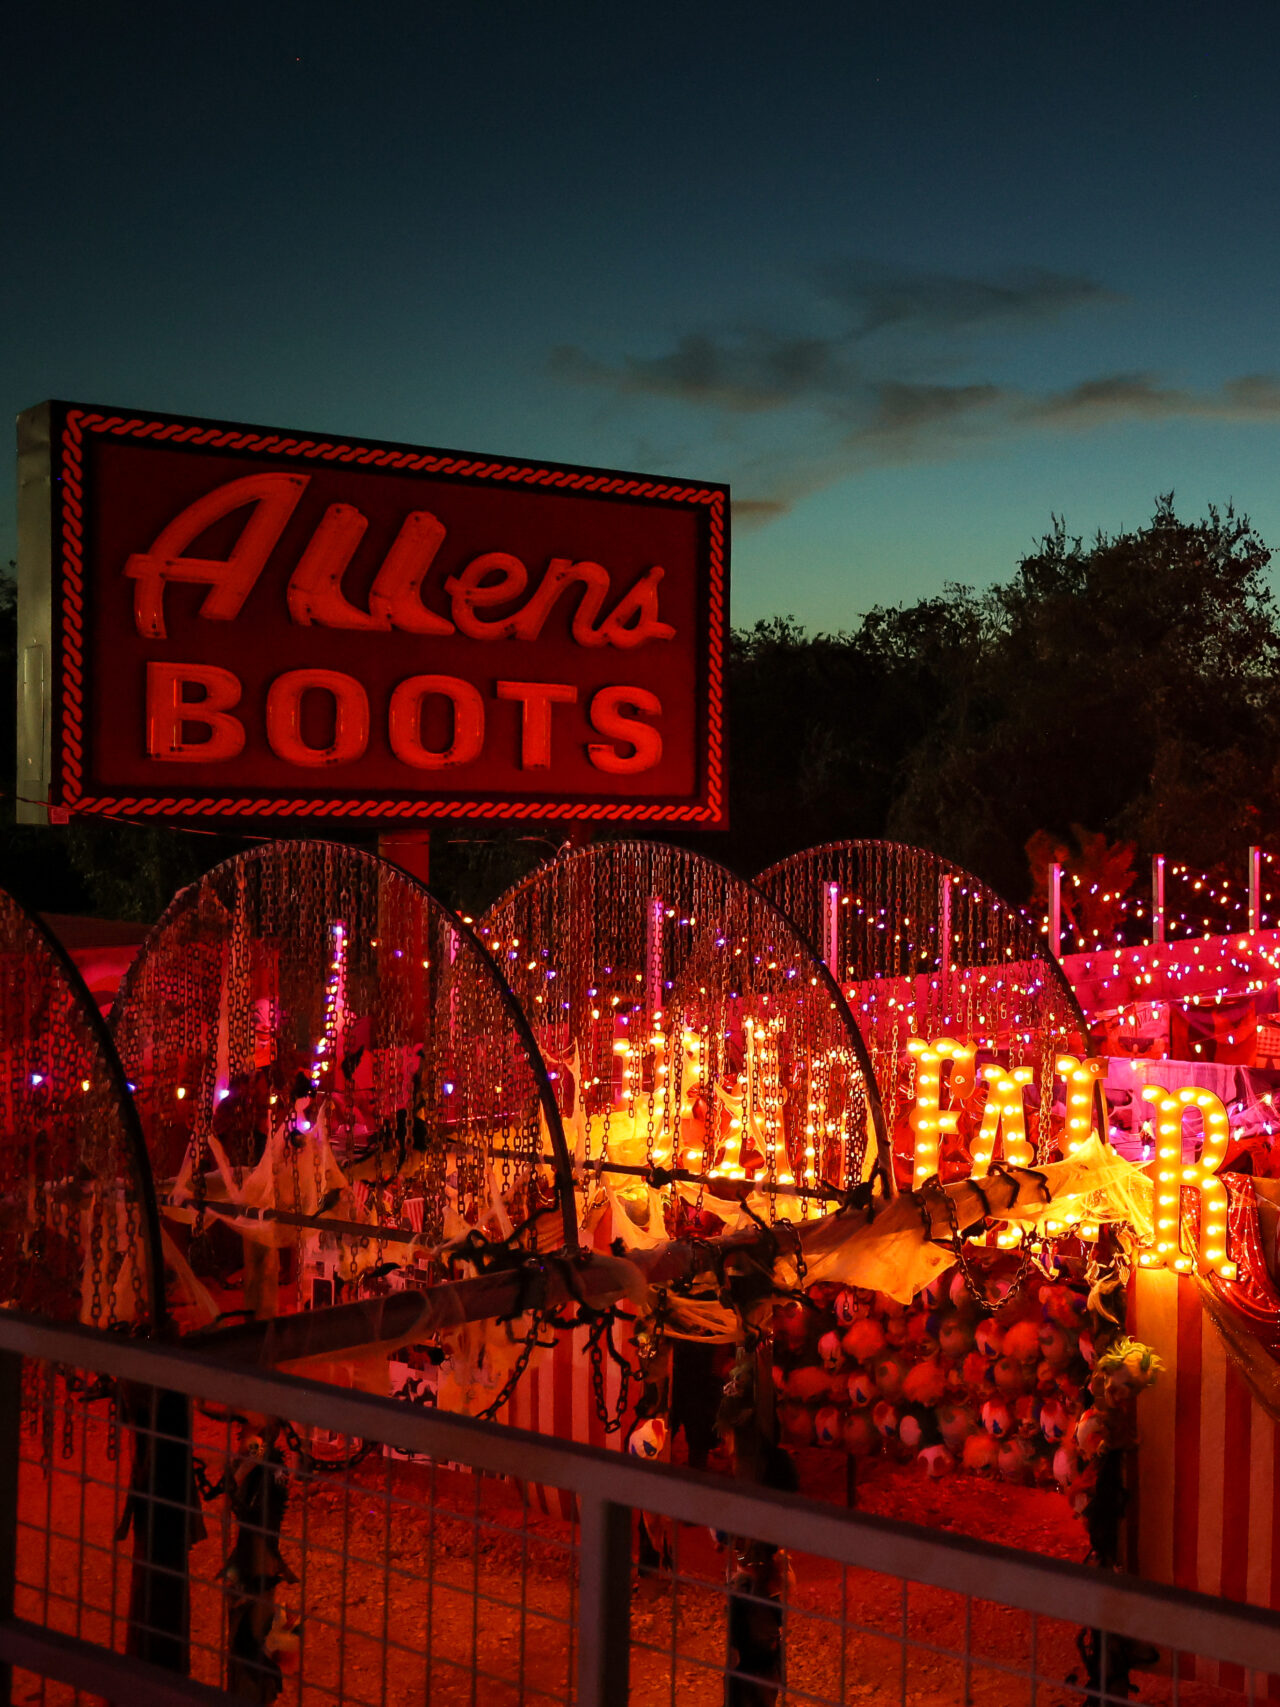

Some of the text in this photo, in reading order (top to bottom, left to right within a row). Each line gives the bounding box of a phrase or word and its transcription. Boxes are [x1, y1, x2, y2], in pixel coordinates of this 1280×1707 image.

[122, 471, 677, 649] Allens
[145, 661, 663, 775] BOOTS
[906, 1037, 1237, 1281] FAIR
